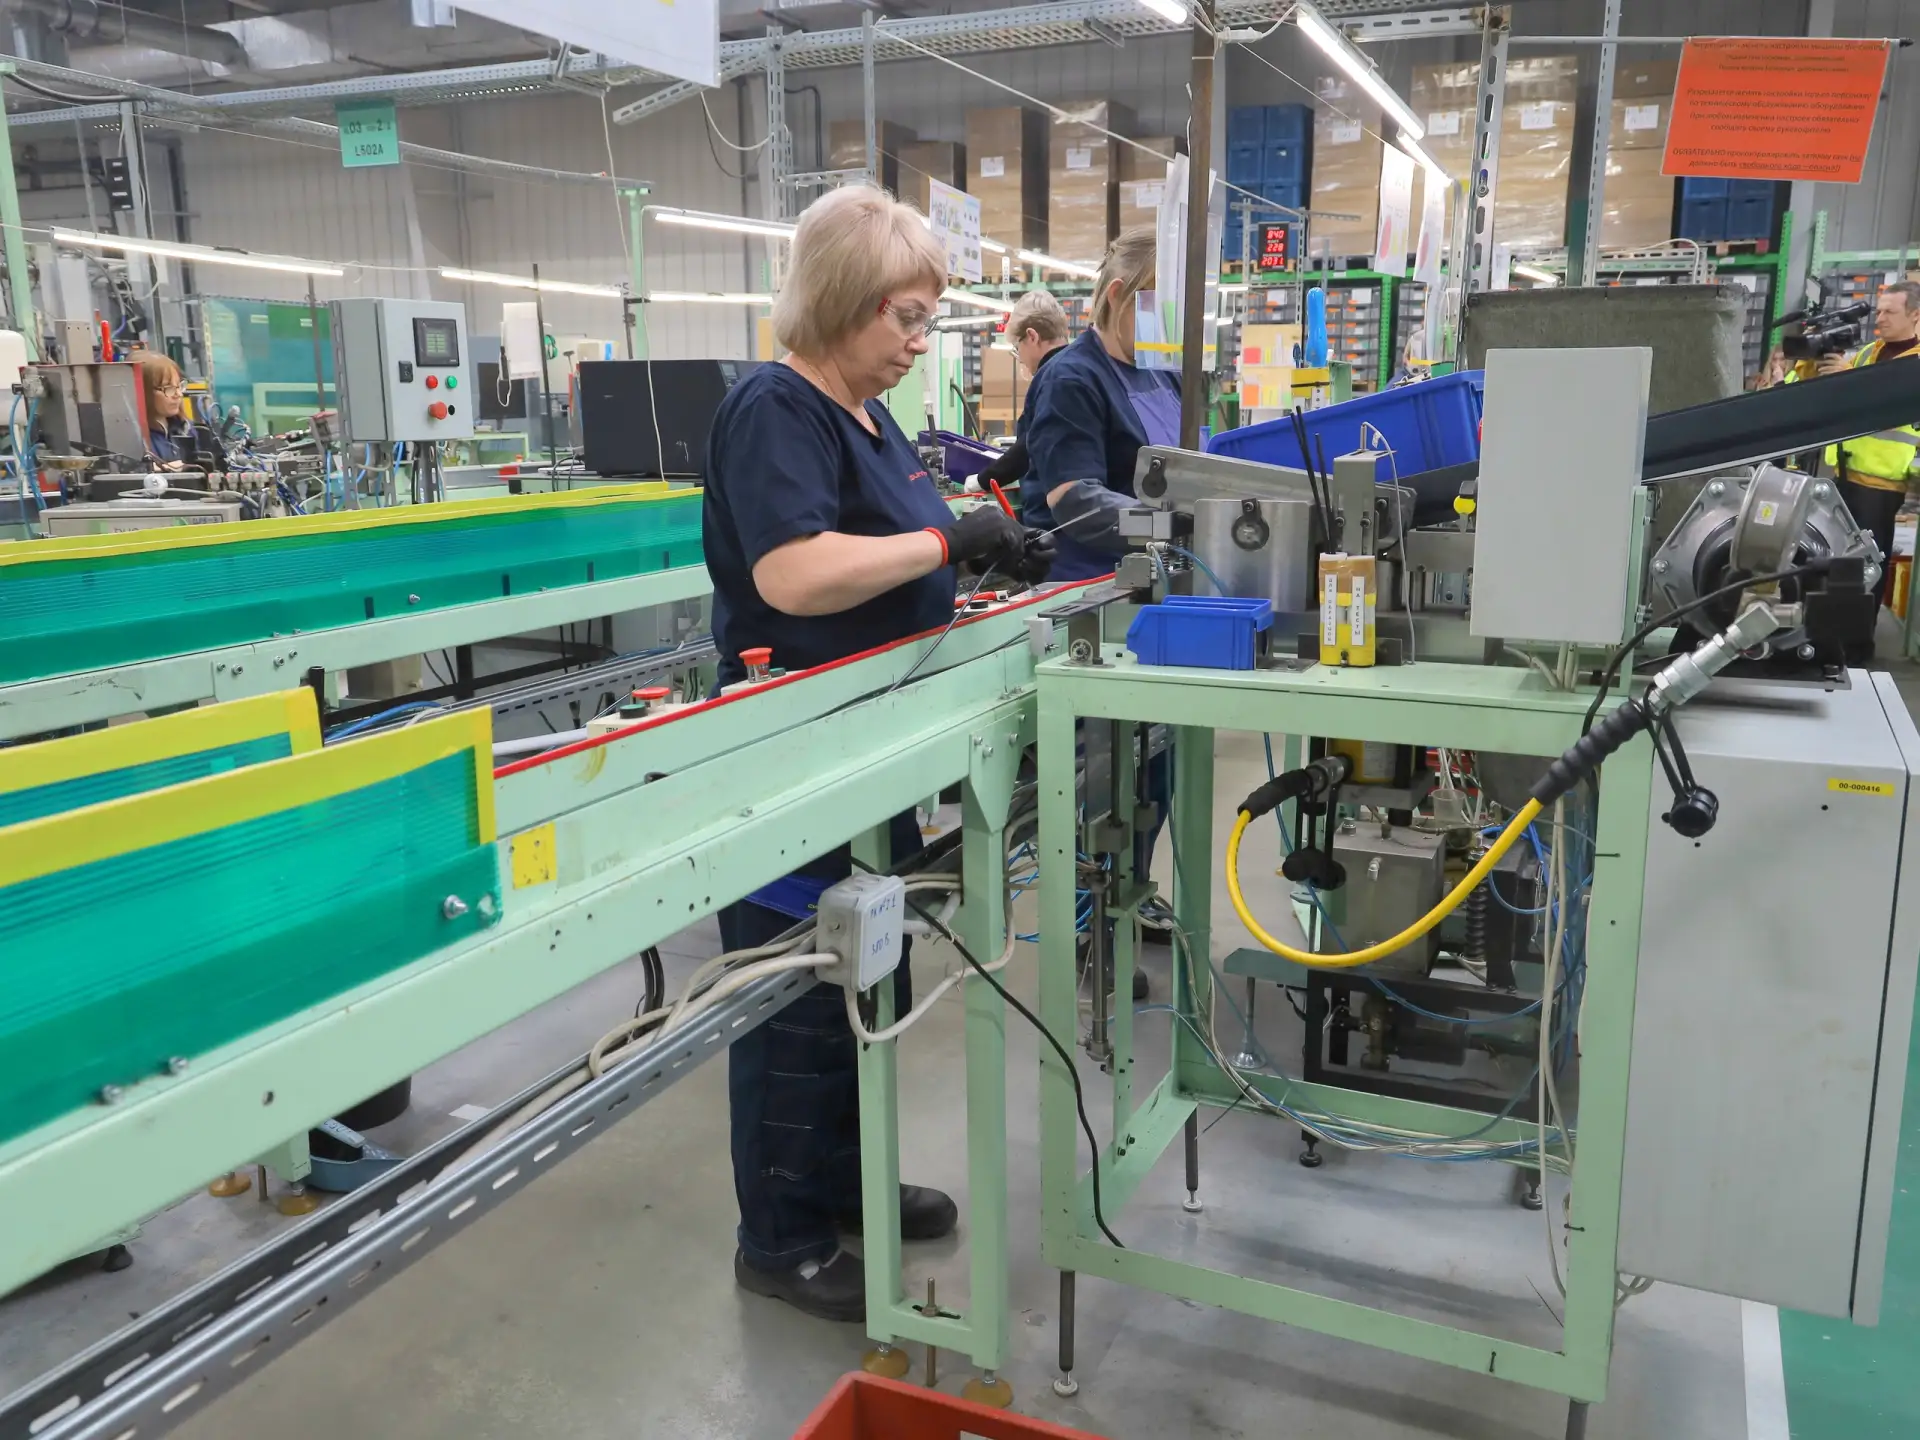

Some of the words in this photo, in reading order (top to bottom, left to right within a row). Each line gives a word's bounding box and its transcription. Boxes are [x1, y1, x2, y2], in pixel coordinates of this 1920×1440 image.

[1672, 147, 1726, 156] ОБЯЗАТЕЛЬНО
[1267, 230, 1285, 240] 840
[1266, 243, 1284, 253] 228
[1839, 783, 1880, 792] 00-000416
